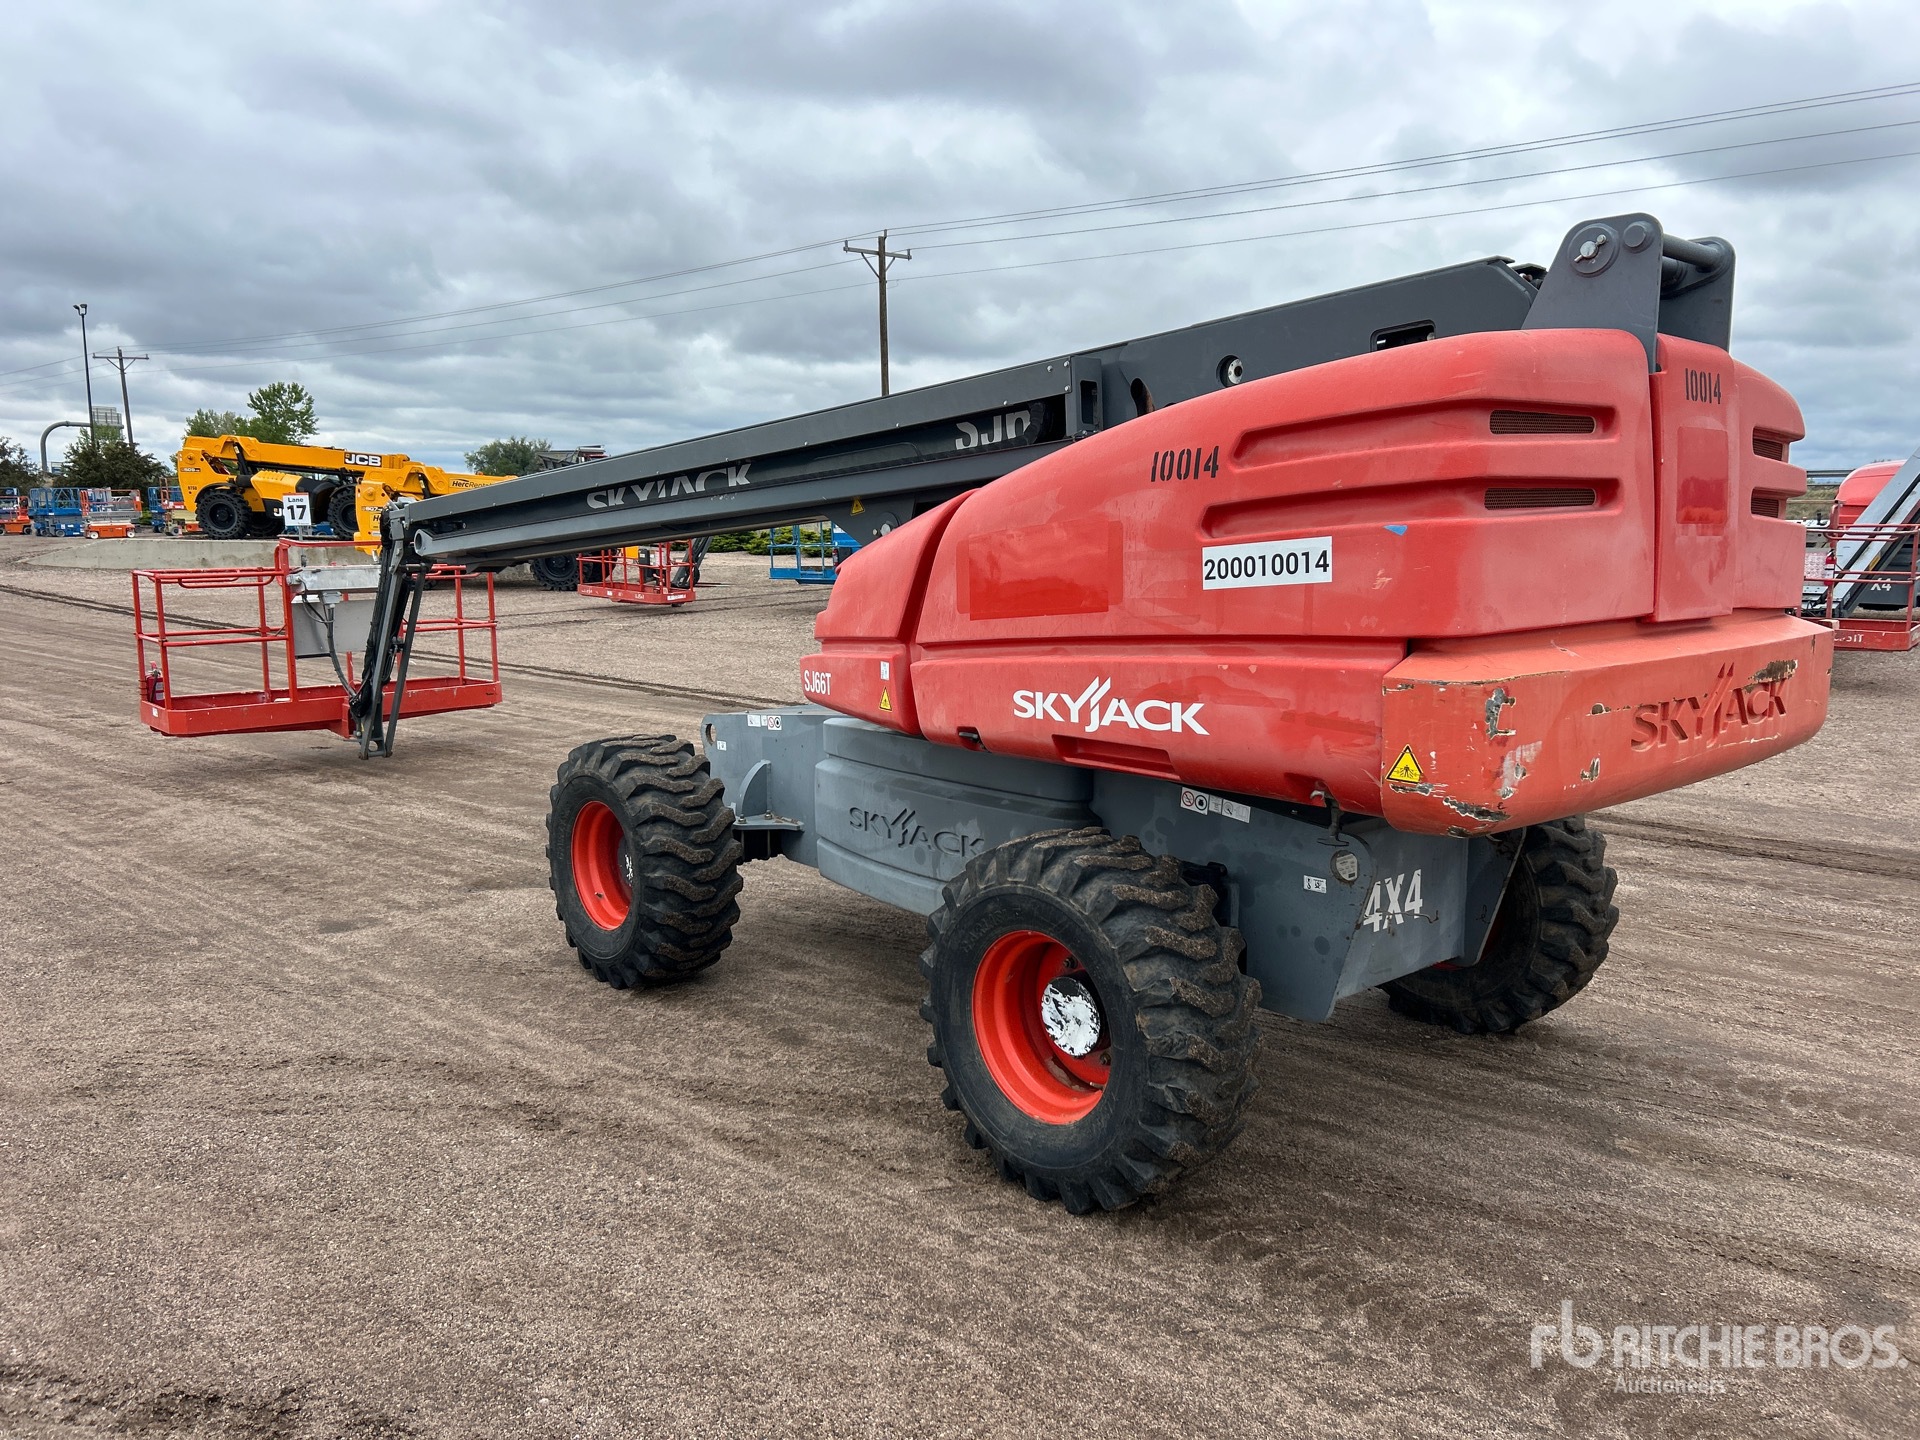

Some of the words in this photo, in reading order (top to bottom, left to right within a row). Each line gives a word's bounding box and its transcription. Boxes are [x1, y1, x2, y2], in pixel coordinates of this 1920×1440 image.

[1685, 367, 1722, 405] 10014
[345, 453, 382, 467] JCB
[1150, 445, 1220, 483] 10014
[286, 504, 307, 521] 17
[1203, 549, 1330, 581] 200010014
[803, 669, 832, 696] SJ66T
[1012, 675, 1211, 737] SKYJACK
[1630, 661, 1787, 753] SKYJACK
[849, 806, 985, 857] SKYJACK
[1362, 868, 1424, 933] 4X4
